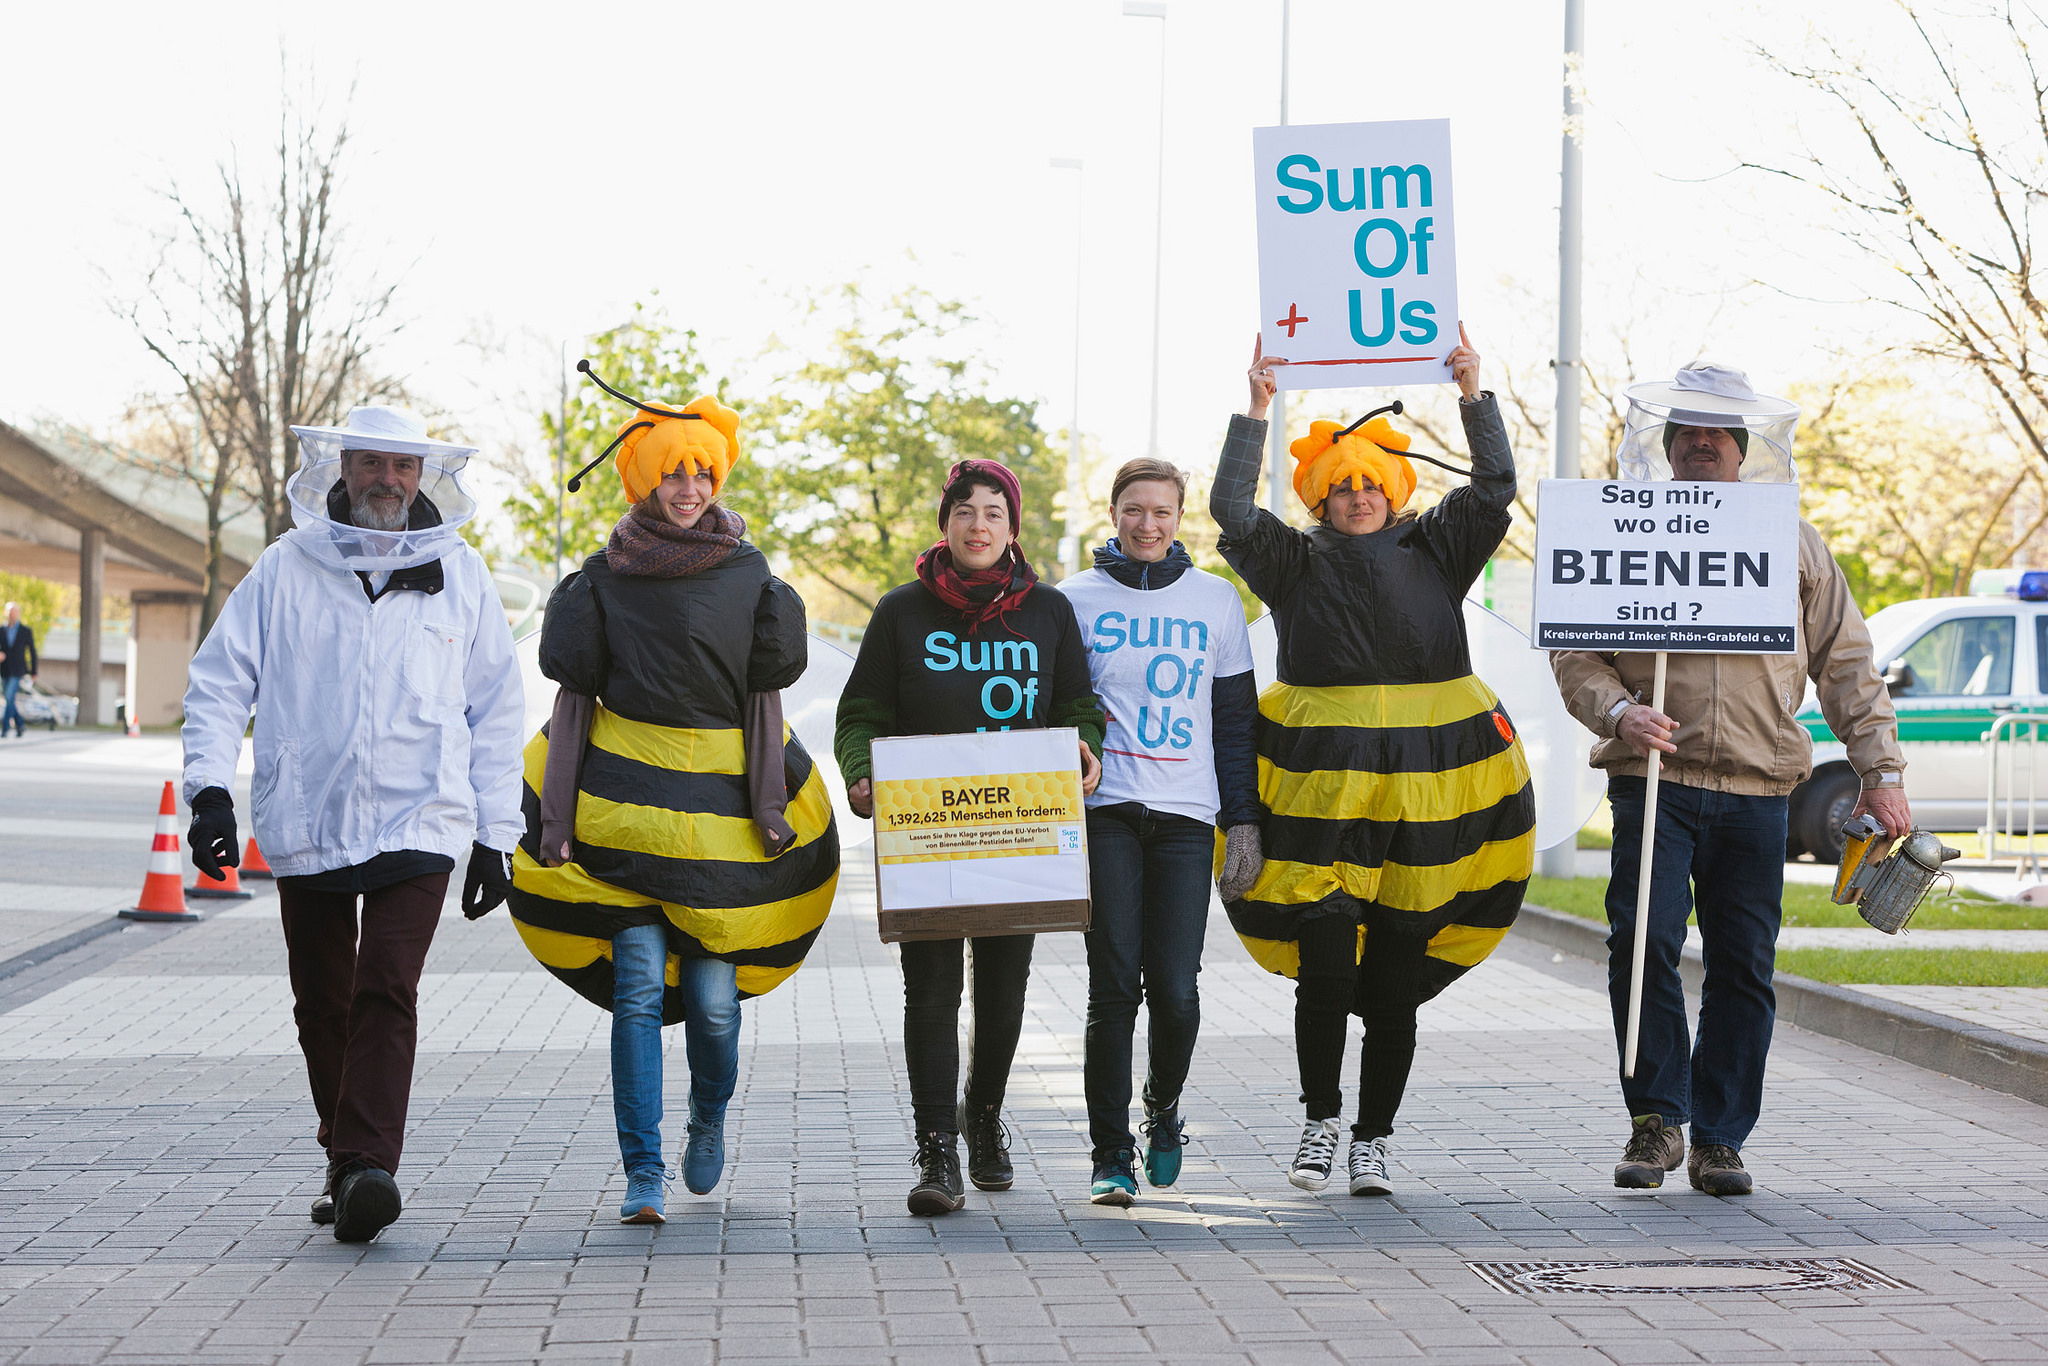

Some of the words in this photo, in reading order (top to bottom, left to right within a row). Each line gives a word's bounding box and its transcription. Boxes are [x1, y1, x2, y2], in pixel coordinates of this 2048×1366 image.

[1276, 153, 1433, 215] Sum
[1353, 217, 1434, 278] Of
[1347, 287, 1439, 348] Us
[1601, 484, 1655, 509] Sag
[1665, 486, 1723, 510] mir,
[1613, 517, 1657, 534] wo
[1666, 514, 1710, 534] die
[1551, 548, 1770, 588] BIENEN
[1616, 601, 1678, 622] sind
[1688, 602, 1703, 622] ?
[1093, 611, 1208, 654] Sum
[1543, 629, 1625, 640] Kreisverband
[1628, 631, 1667, 641] Imker
[1670, 632, 1760, 642] Rhön-Grabfeld
[1763, 635, 1774, 643] e.
[1778, 633, 1790, 643] V.
[924, 630, 1039, 672] Sum
[1146, 653, 1205, 700] Of
[980, 675, 1039, 720] Of
[1137, 706, 1194, 750] Us
[942, 786, 1011, 807] BAYER
[888, 811, 947, 826] 1,392,625
[950, 808, 1013, 822] Menschen
[1016, 805, 1066, 818] fordern:
[939, 837, 1013, 848] Bienenkiller-Pestiziden
[944, 831, 958, 839] Ihre
[959, 830, 978, 839] Klage
[979, 829, 1001, 838] gegen
[1002, 827, 1014, 835] das
[1015, 826, 1050, 835] EU-Verbot
[1061, 829, 1078, 837] Sum
